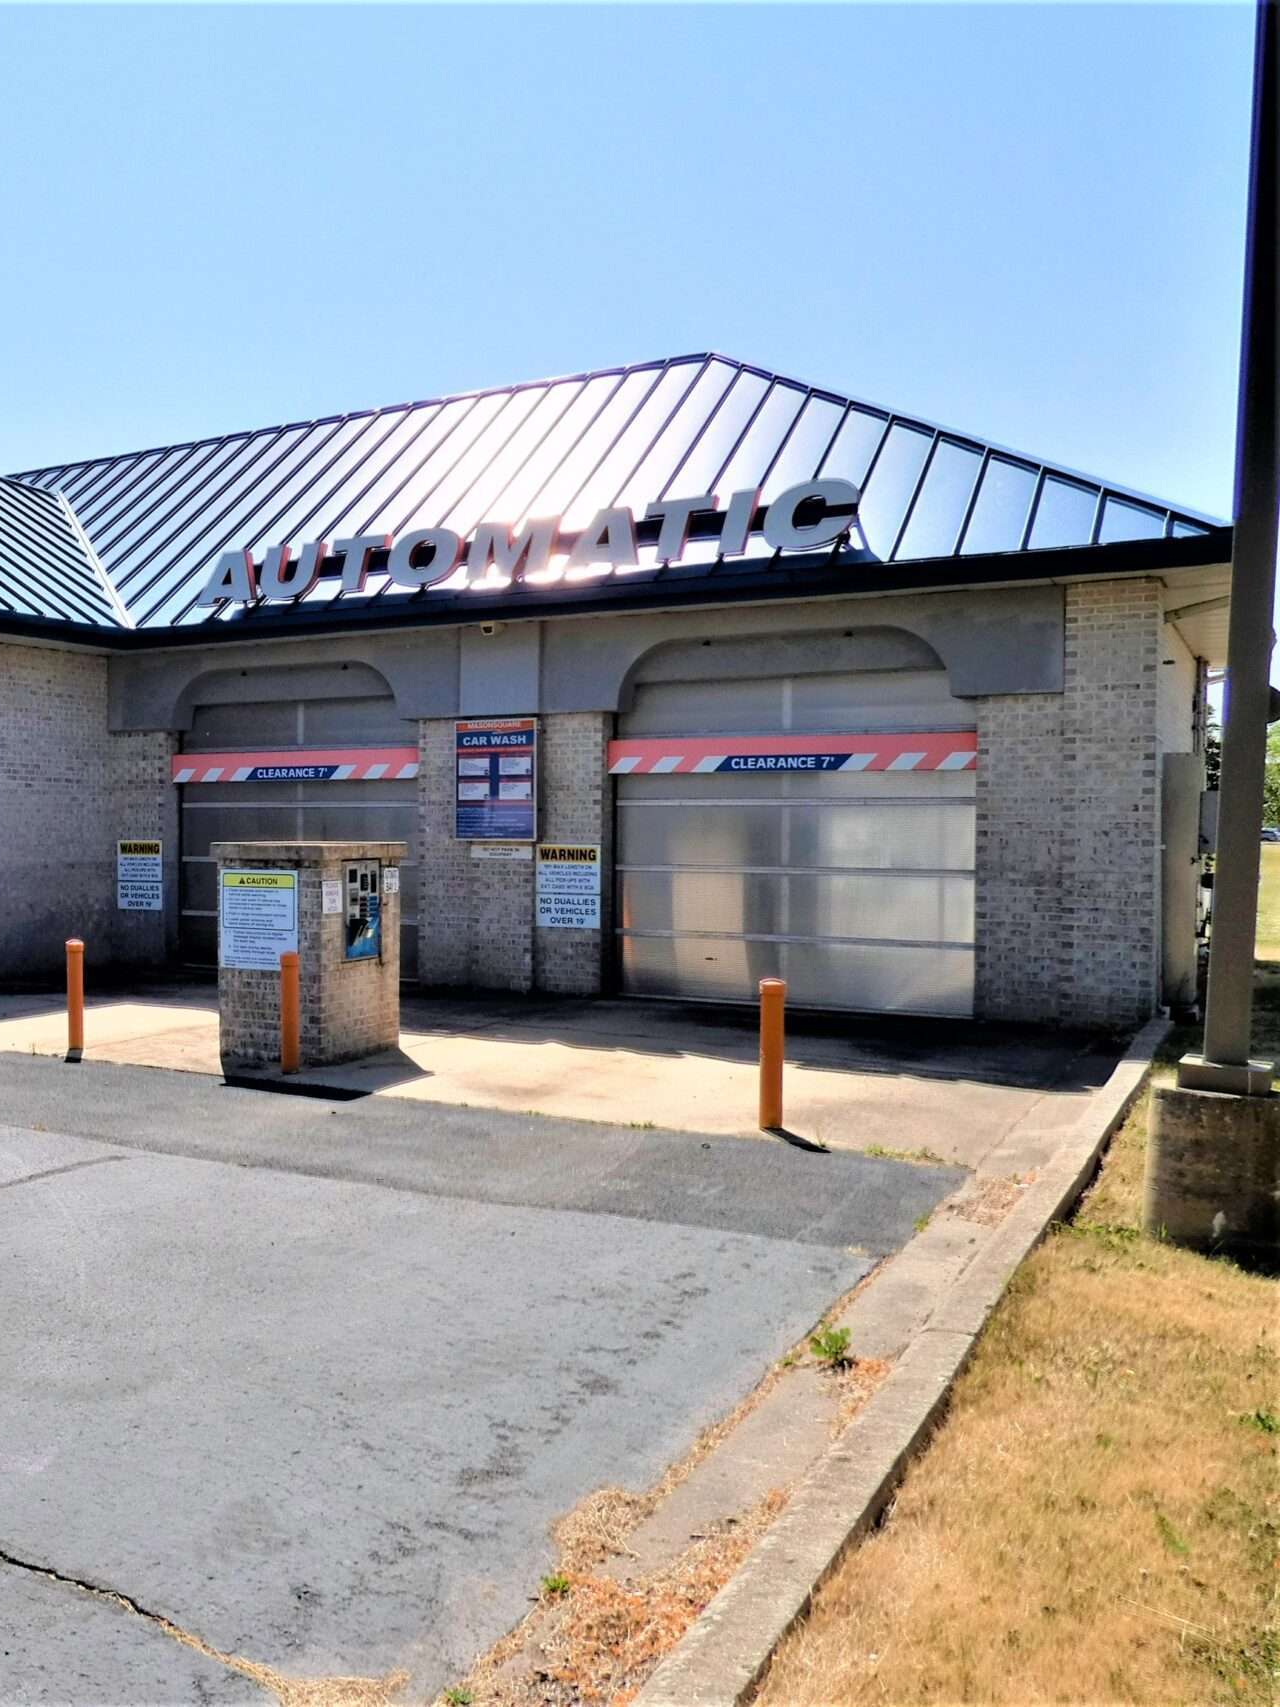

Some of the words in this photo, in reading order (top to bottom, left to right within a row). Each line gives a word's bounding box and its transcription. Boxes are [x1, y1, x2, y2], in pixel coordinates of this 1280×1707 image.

[195, 478, 860, 606] AUTOMATIC
[462, 736, 488, 746] CAR
[490, 735, 527, 745] WASH
[730, 756, 816, 769] CLEARANCE
[820, 756, 835, 768] 7'
[257, 768, 315, 778] CLEARANCE
[318, 767, 328, 777] 7'
[120, 843, 160, 854] WARNING
[540, 848, 597, 861] WARNING
[246, 877, 278, 885] CAUTION
[130, 892, 160, 900] VEHICLES
[540, 897, 552, 905] NO
[554, 897, 596, 906] DUALLIES
[554, 907, 597, 916] VEHICLES
